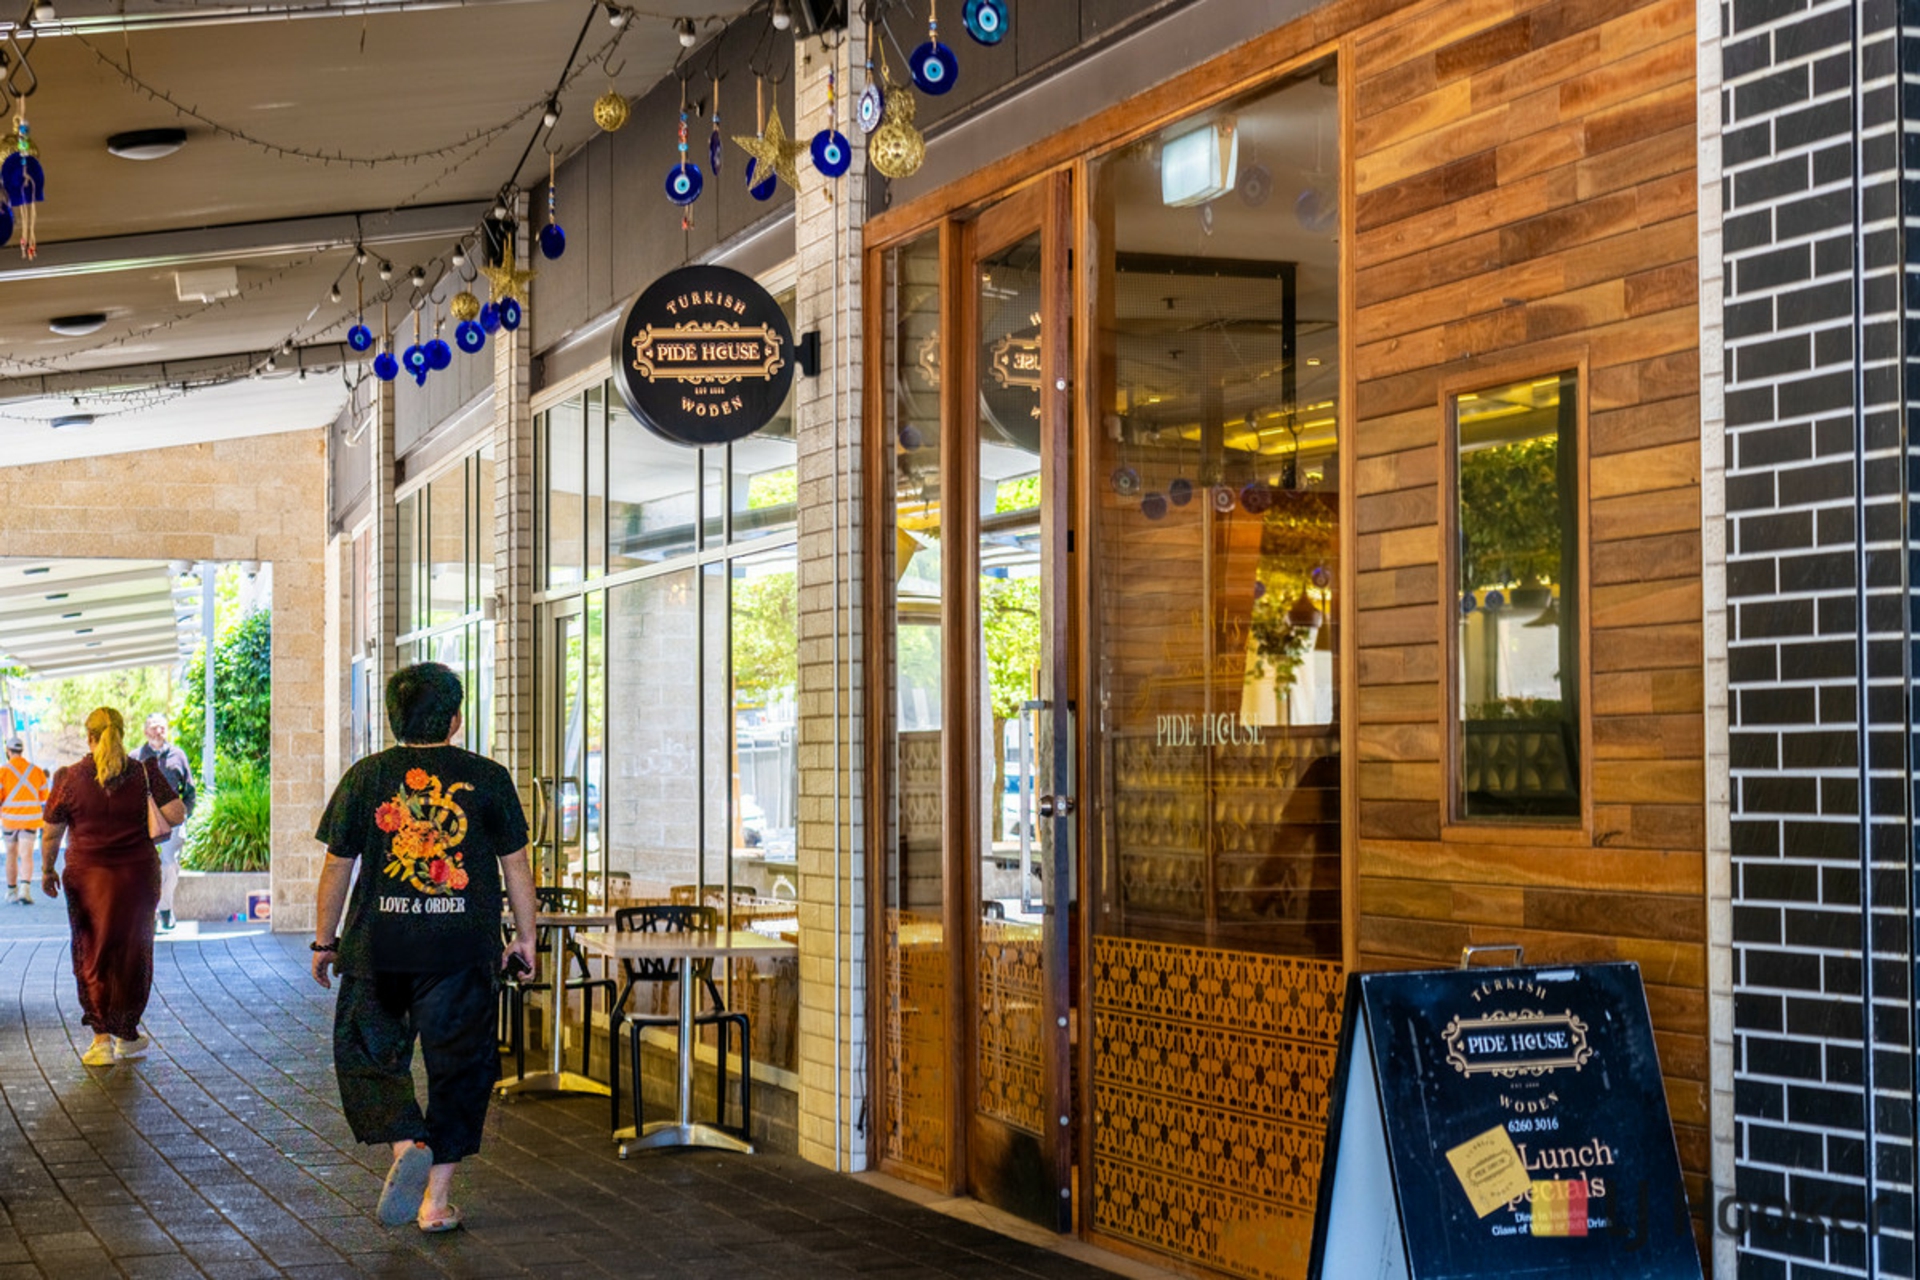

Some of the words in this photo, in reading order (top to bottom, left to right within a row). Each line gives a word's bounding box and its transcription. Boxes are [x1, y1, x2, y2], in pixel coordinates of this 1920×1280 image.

[666, 290, 747, 316] TURKISH
[656, 343, 697, 361] PIDE
[701, 342, 761, 361] HOUSE
[681, 395, 743, 417] WODEN
[1156, 714, 1197, 746] PIDE
[1202, 712, 1266, 746] HOUSE
[379, 896, 410, 913] LOVE
[411, 897, 422, 914] &
[424, 897, 466, 914] ORDER
[1471, 978, 1547, 1002] TURKISH
[1467, 1034, 1508, 1054] PIDE
[1511, 1031, 1569, 1051] HOUSE
[1500, 1091, 1559, 1114] WODEN
[1508, 1119, 1533, 1133] 6260
[1535, 1117, 1560, 1131] 3016
[1517, 1137, 1615, 1171] Lunch
